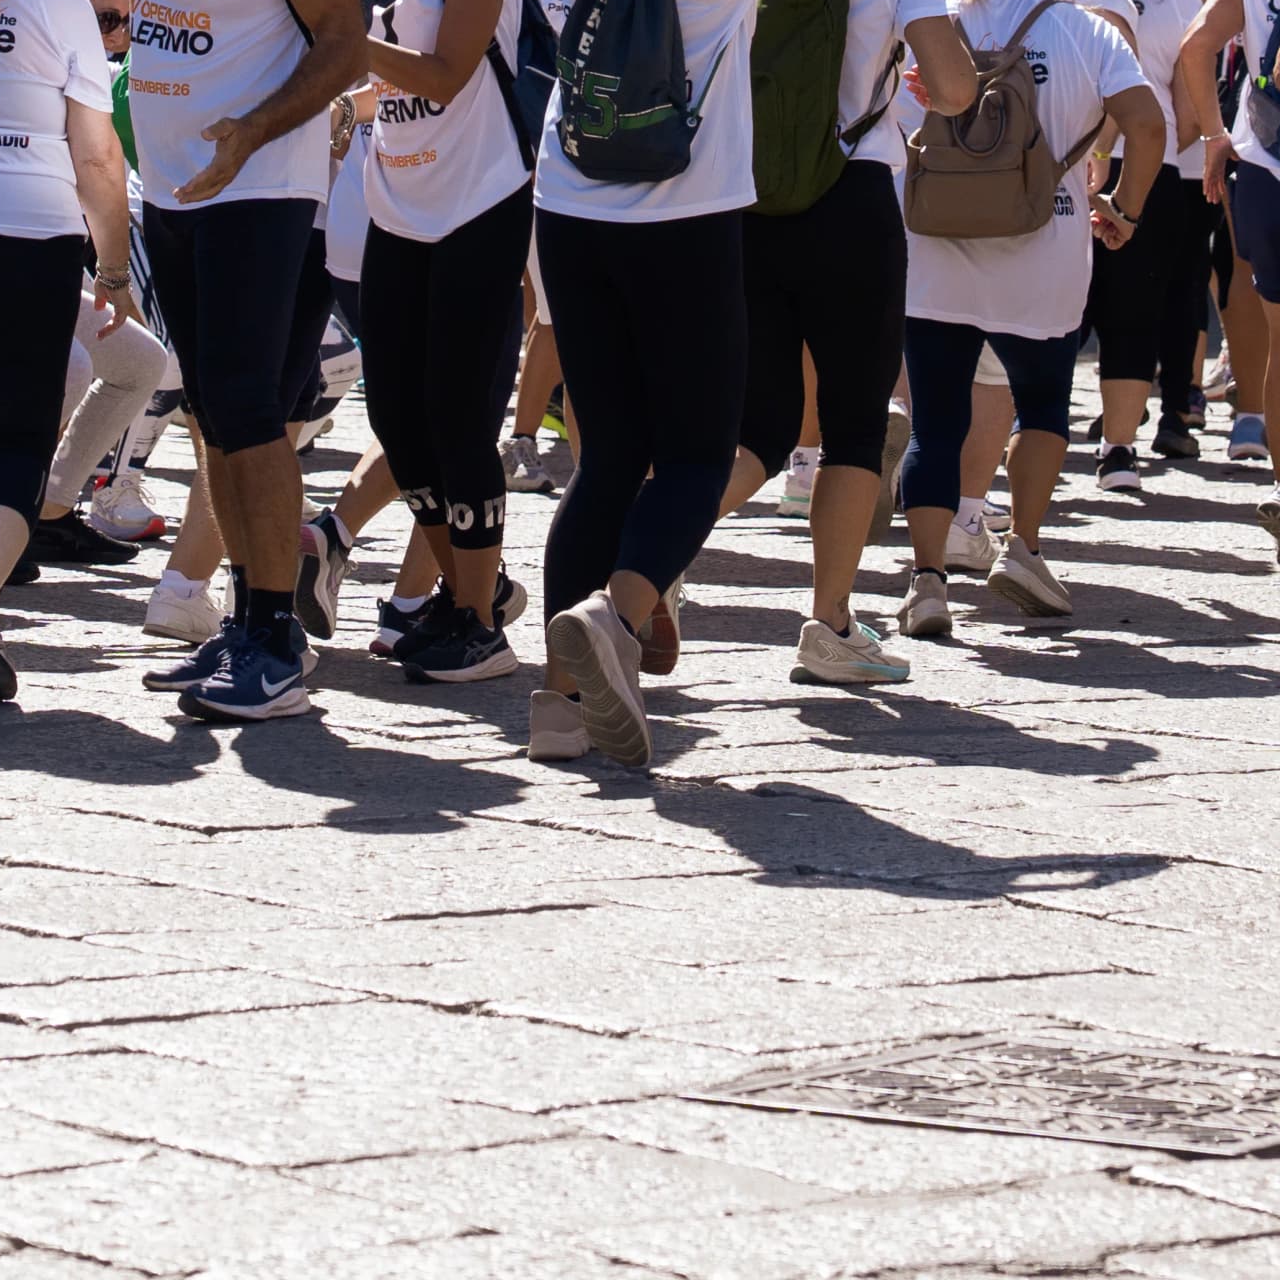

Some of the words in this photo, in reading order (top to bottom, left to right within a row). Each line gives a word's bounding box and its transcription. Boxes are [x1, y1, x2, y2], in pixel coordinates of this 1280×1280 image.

[140, 0, 211, 31] OPENING
[130, 17, 214, 56] LERMO
[1027, 49, 1047, 60] the
[129, 77, 171, 96] TEMBRE
[172, 83, 190, 97] 26
[421, 149, 437, 165] 26
[400, 486, 438, 511] ST
[483, 494, 506, 529] IT
